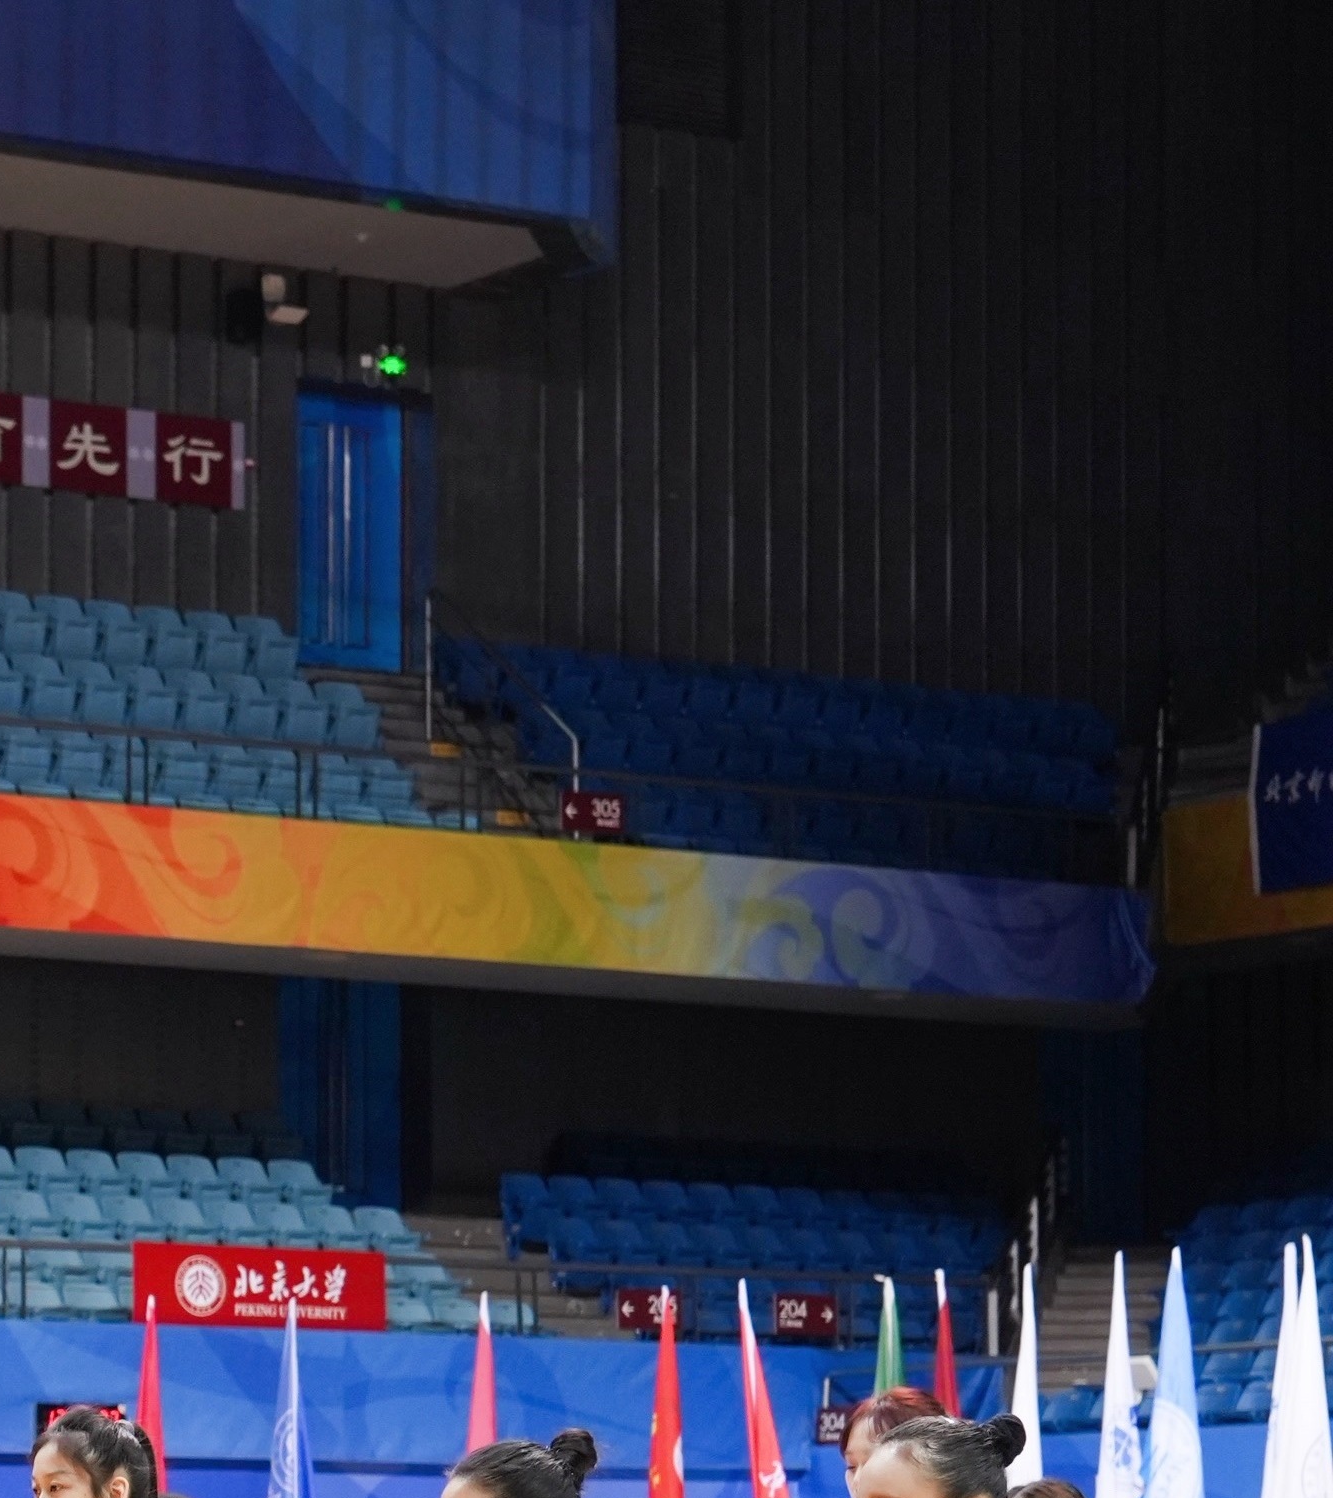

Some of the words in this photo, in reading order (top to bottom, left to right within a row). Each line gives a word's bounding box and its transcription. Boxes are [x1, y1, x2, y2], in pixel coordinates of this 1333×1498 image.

[591, 798, 621, 819] 305
[234, 1260, 347, 1304] 北京大学
[234, 1303, 277, 1318] PEKING
[779, 1299, 807, 1320] 204
